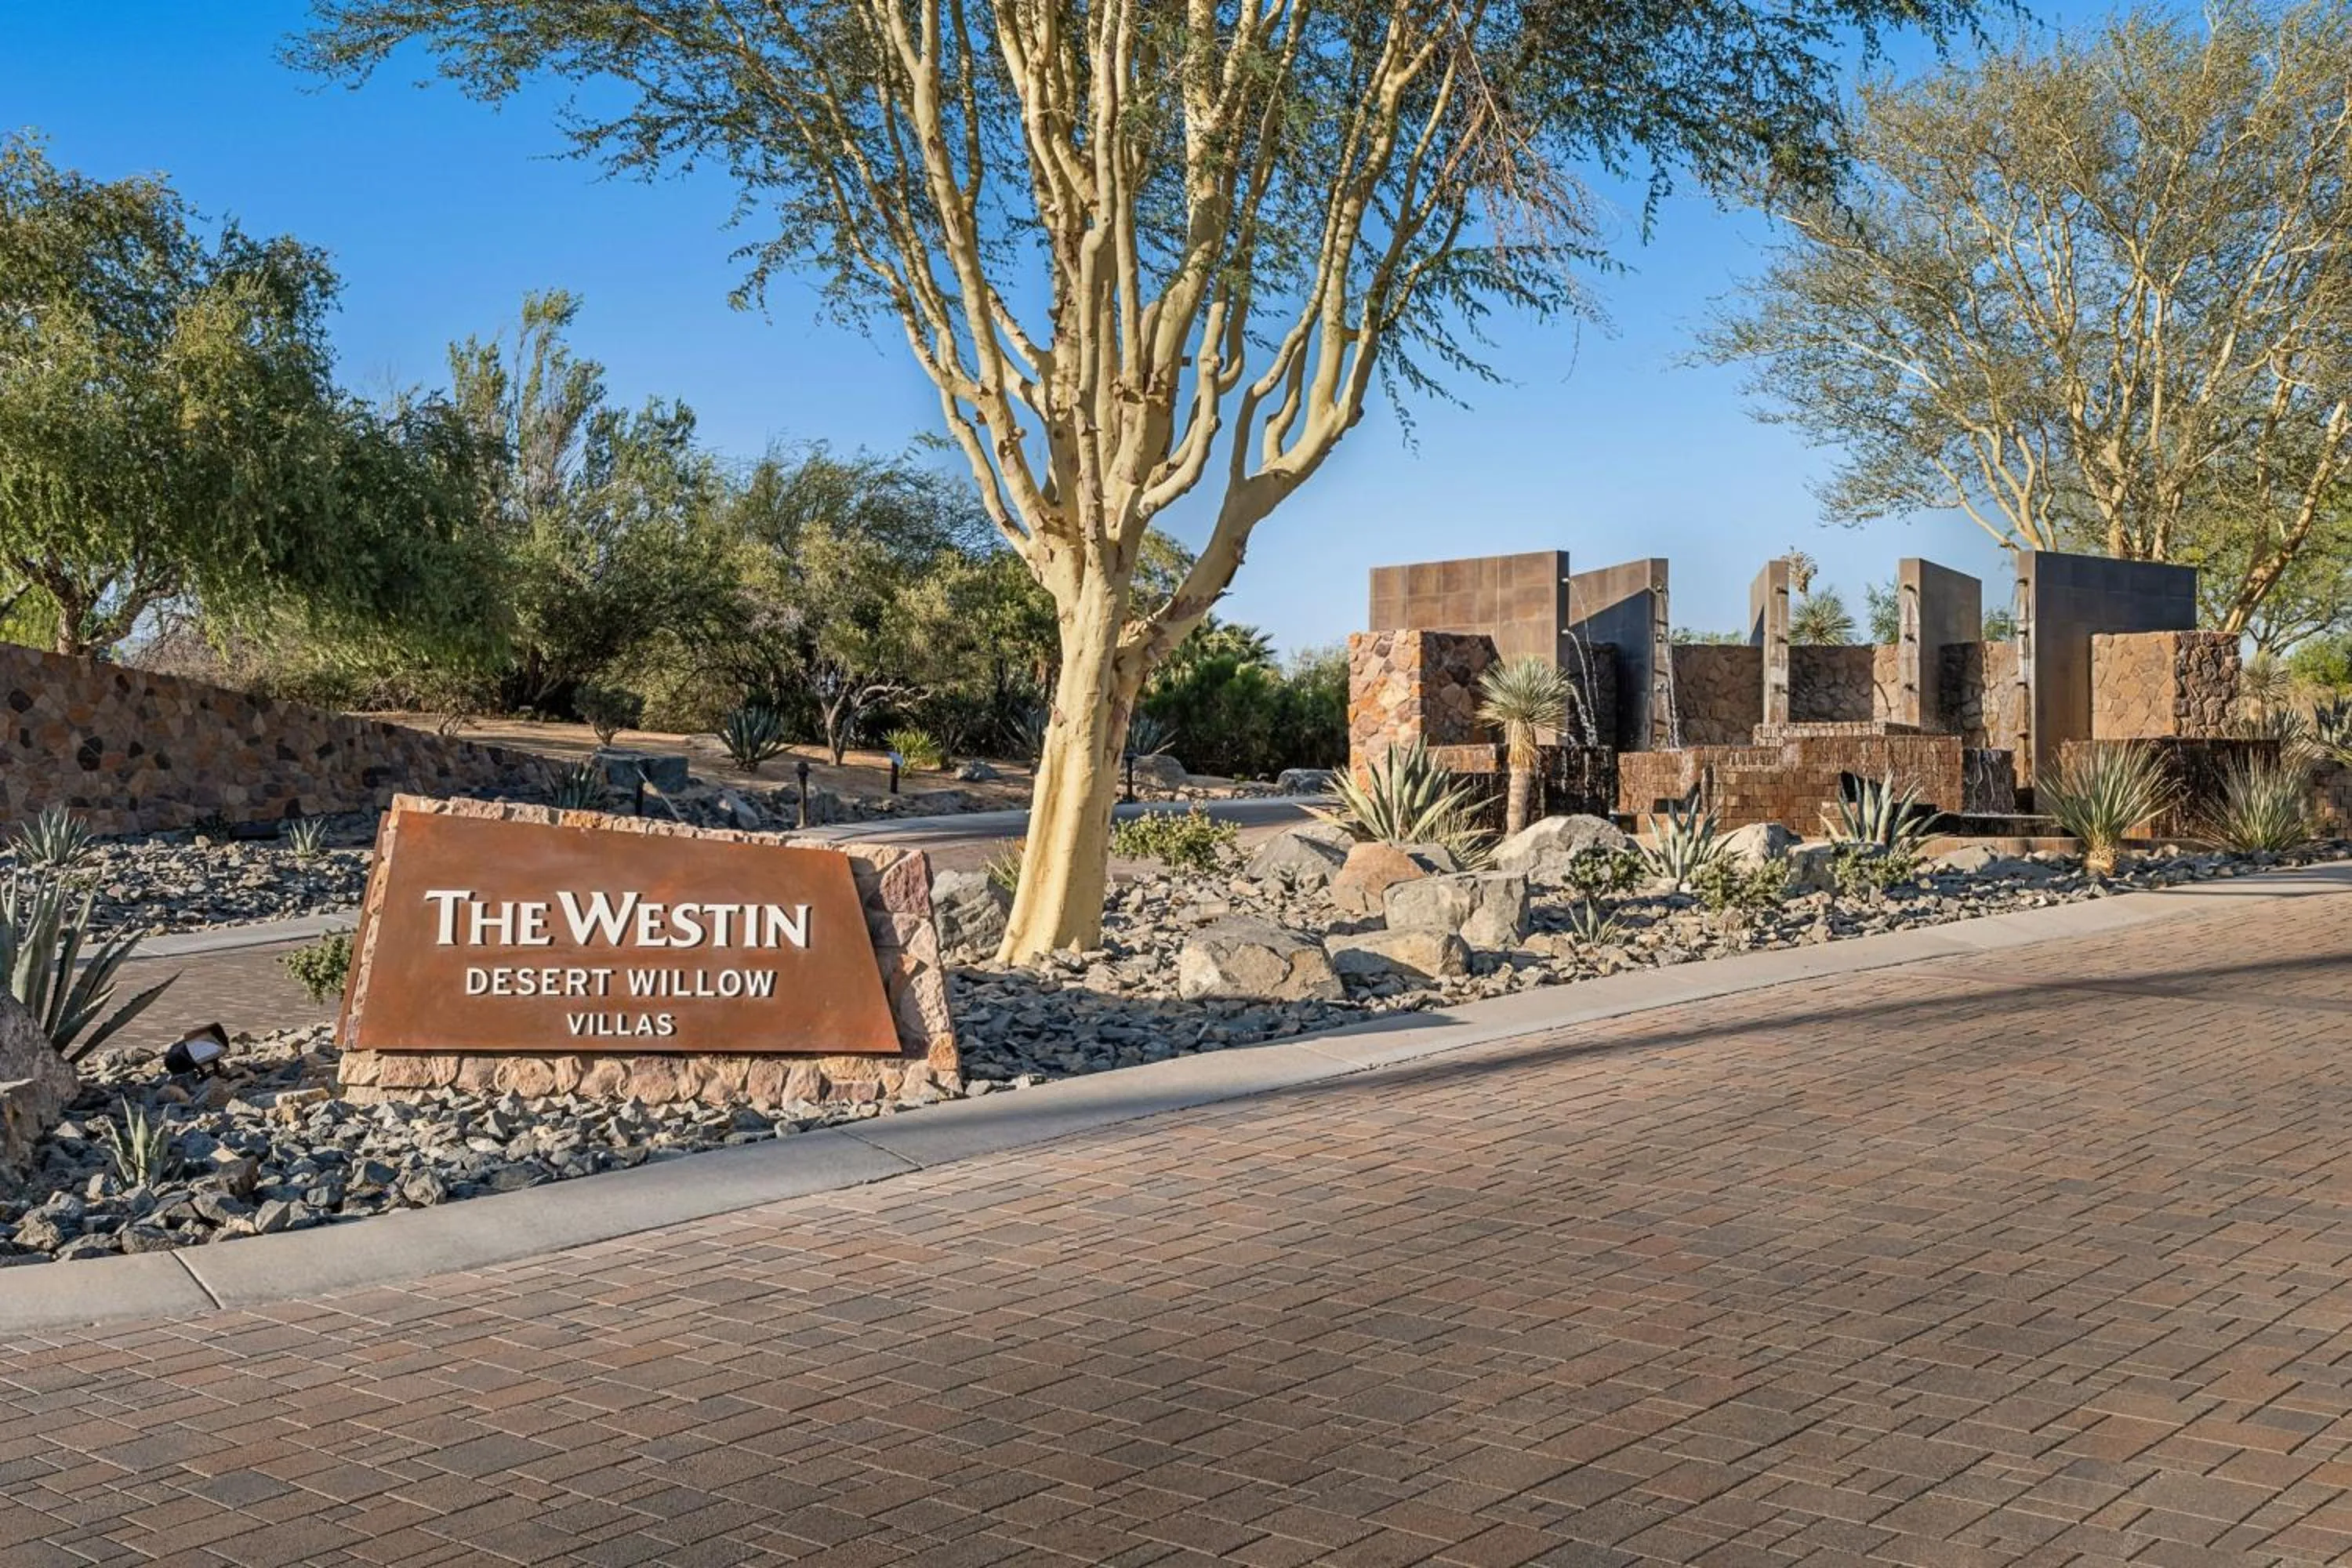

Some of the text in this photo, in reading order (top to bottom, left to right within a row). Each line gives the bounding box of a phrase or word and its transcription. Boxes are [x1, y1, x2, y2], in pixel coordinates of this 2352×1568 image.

[423, 889, 809, 949] THE WESTIN
[465, 967, 774, 999] DESERT WILLOW
[566, 1012, 673, 1038] VILLAS
